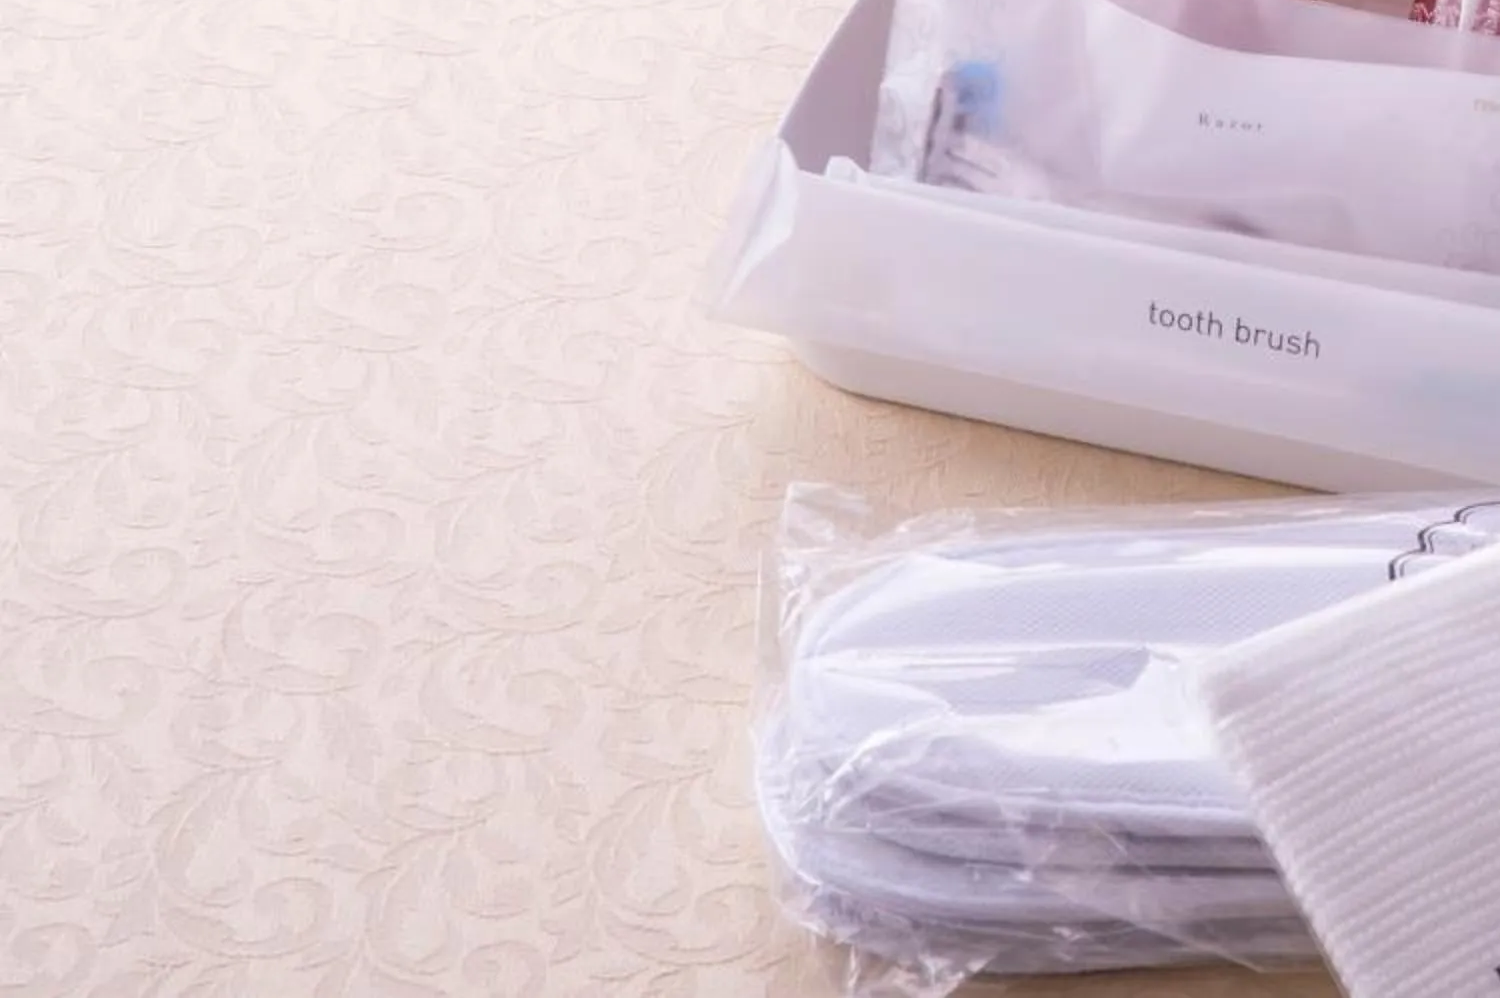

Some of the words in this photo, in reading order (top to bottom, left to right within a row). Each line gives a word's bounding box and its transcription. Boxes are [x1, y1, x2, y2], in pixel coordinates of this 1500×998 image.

[1198, 112, 1265, 132] Razor
[1149, 302, 1223, 339] tooth
[1234, 317, 1322, 359] brush
